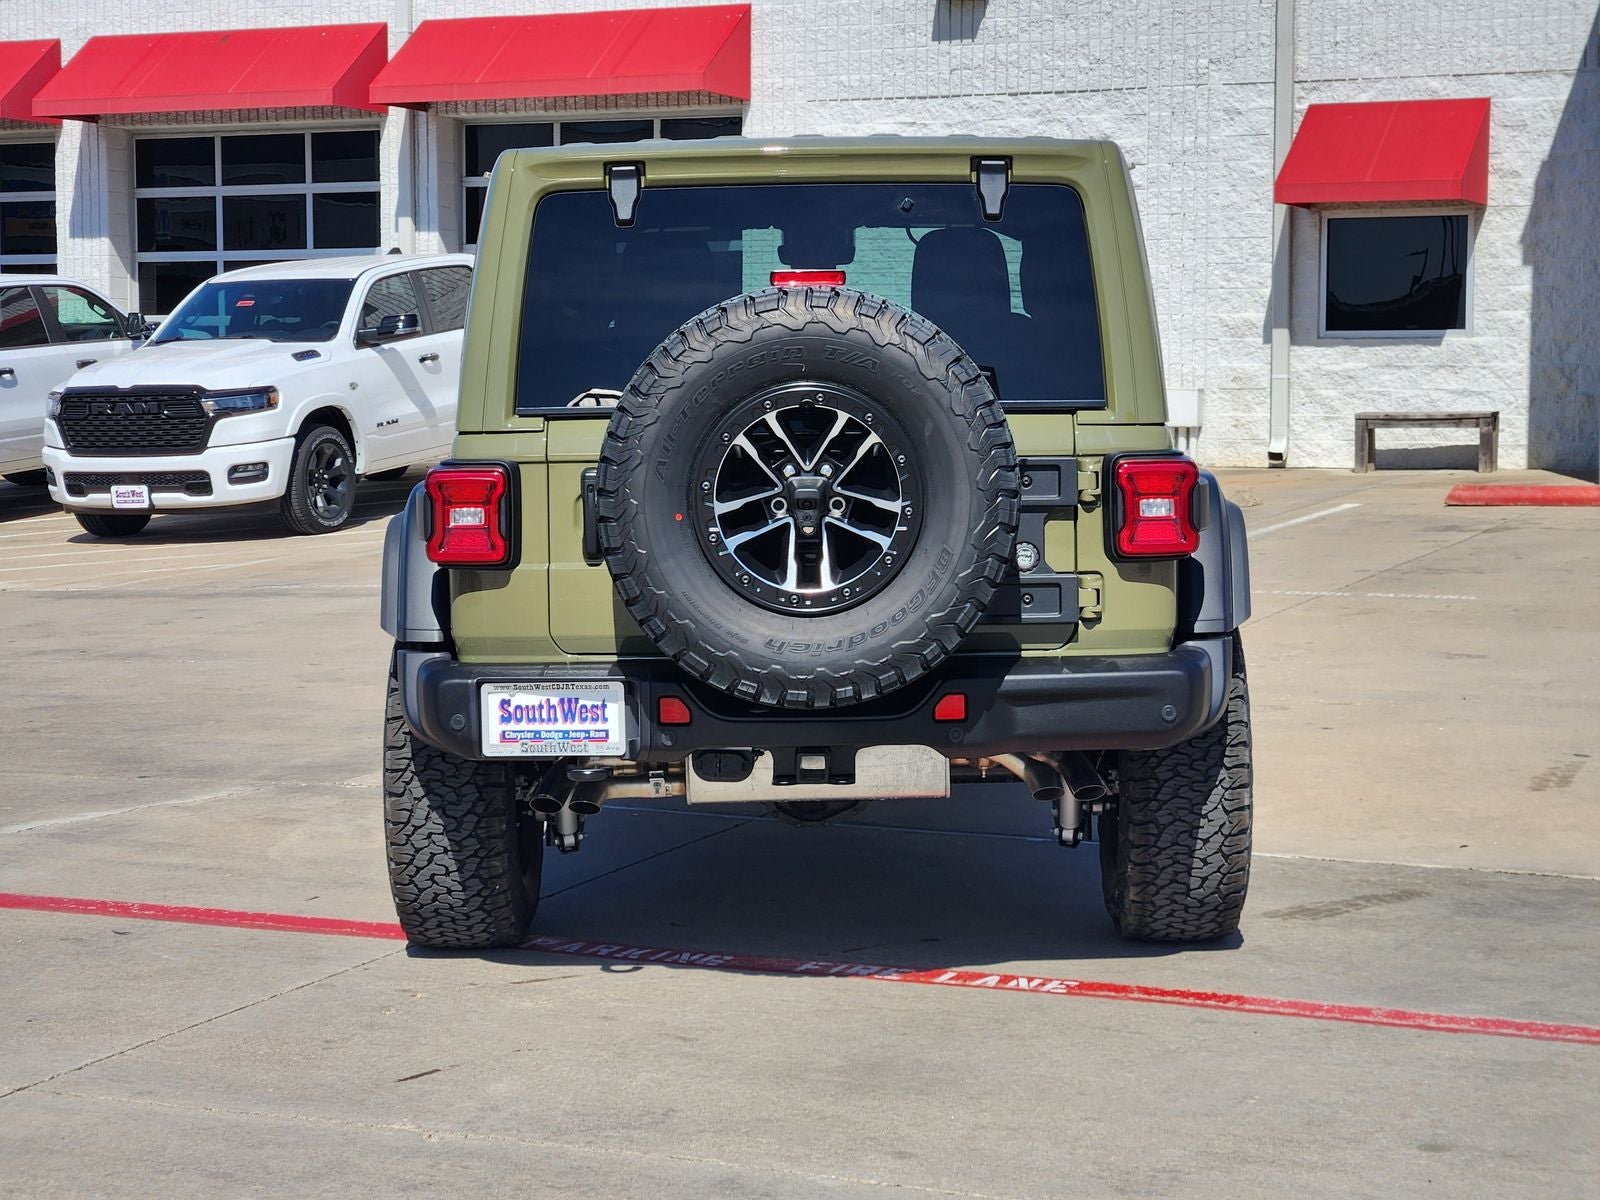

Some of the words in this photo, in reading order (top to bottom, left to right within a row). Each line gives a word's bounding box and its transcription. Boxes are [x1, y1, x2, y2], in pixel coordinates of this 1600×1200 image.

[824, 345, 881, 374] T/A
[91, 402, 160, 414] RAM
[377, 418, 399, 428] RAM
[764, 544, 953, 657] BFGoodrich
[499, 697, 609, 725] SouthWest
[504, 730, 535, 739] Chrysler
[540, 731, 563, 739] Dodge
[568, 731, 586, 739] Jeep
[589, 730, 606, 738] Ram
[520, 742, 589, 753] SouthWest
[934, 971, 1080, 994] LANE
